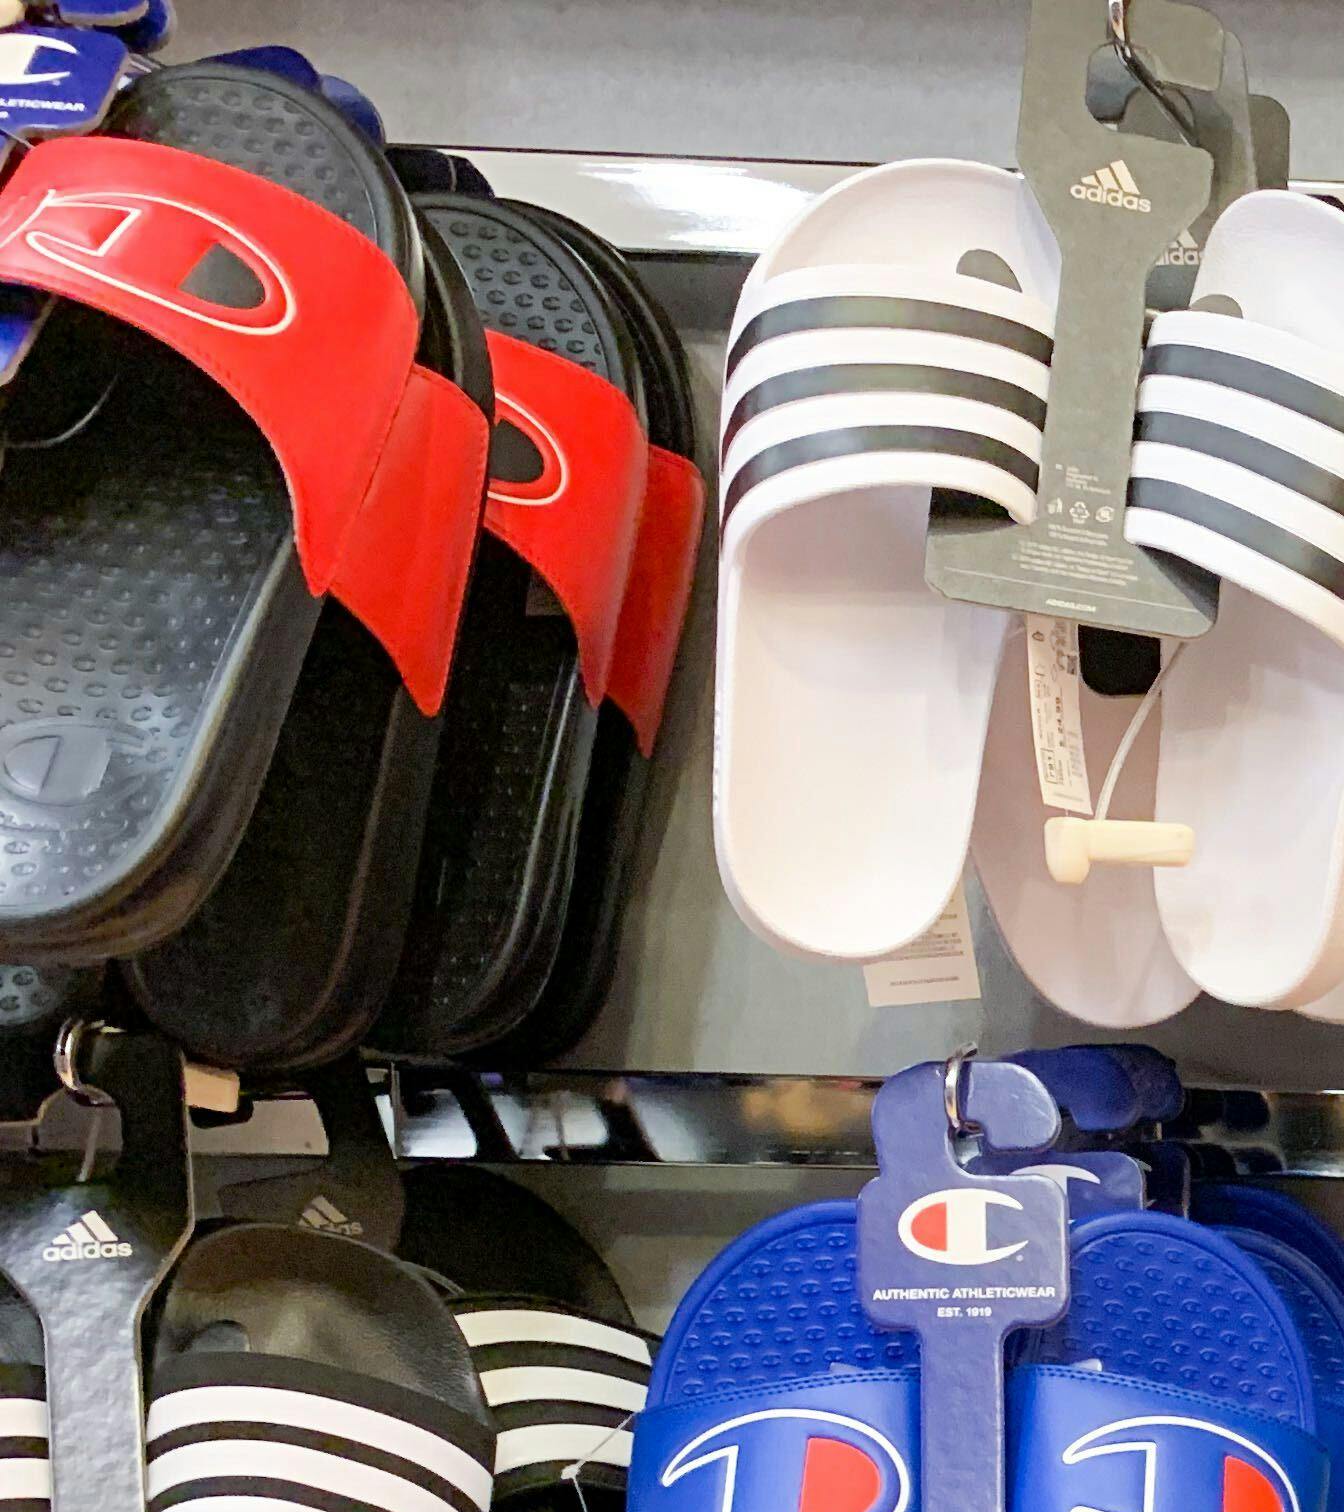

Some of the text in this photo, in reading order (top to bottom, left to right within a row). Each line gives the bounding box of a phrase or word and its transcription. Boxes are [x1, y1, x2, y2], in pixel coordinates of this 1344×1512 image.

[1070, 183, 1152, 213] adidas
[42, 1240, 133, 1262] adidas
[872, 1286, 1056, 1301] AUTHENTIC ATHLETICWEAR
[937, 1306, 993, 1318] EST. 1919
